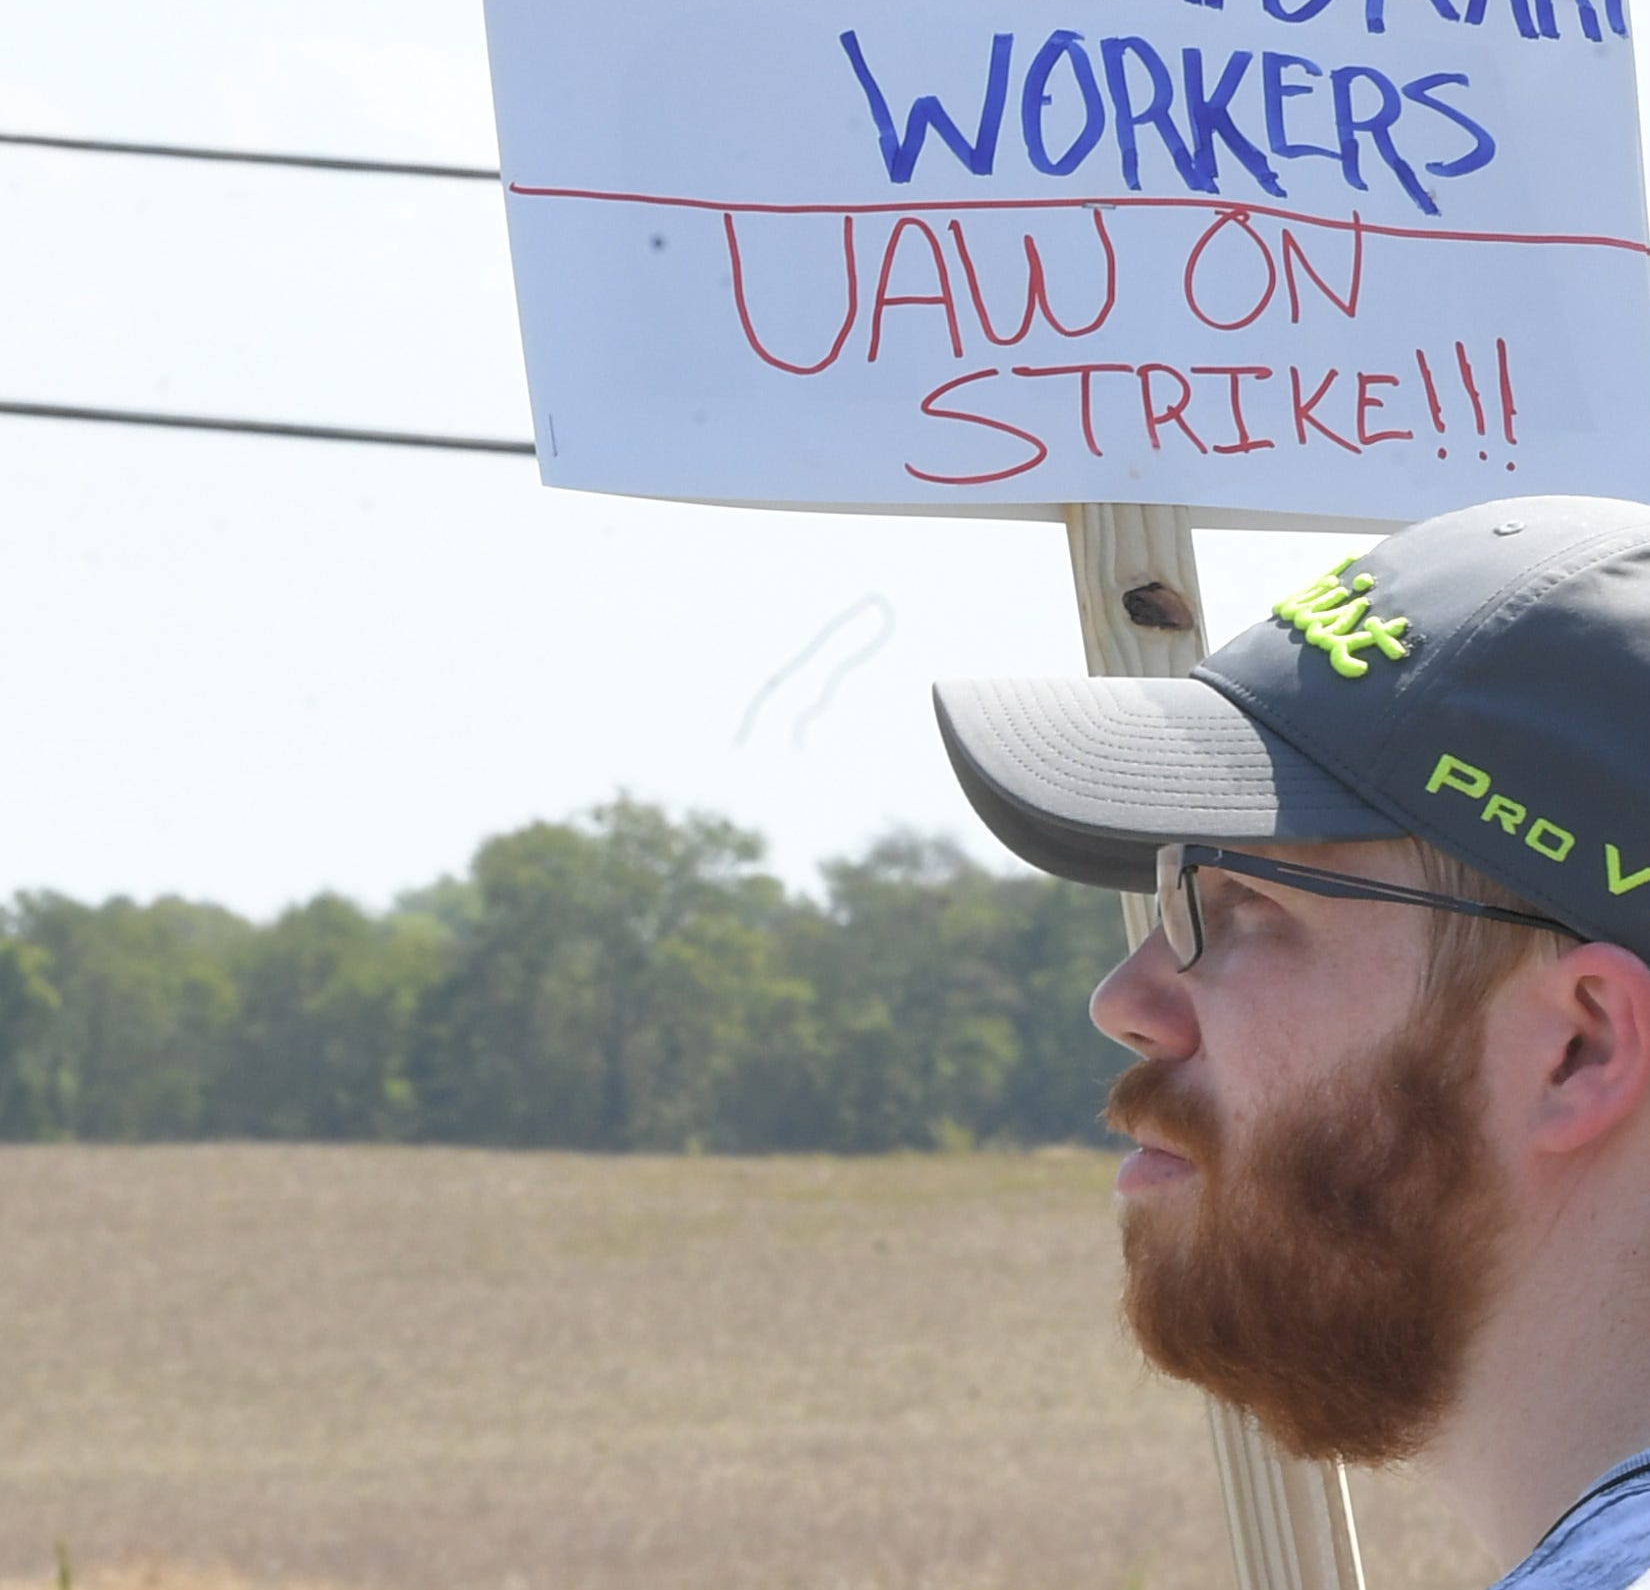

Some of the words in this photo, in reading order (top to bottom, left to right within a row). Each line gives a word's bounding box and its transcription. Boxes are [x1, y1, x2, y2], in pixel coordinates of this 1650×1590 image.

[839, 31, 1497, 215] WORKERS
[724, 209, 1117, 374] UAW
[1184, 209, 1363, 329] ON
[905, 338, 1518, 485] STRIKE!!!
